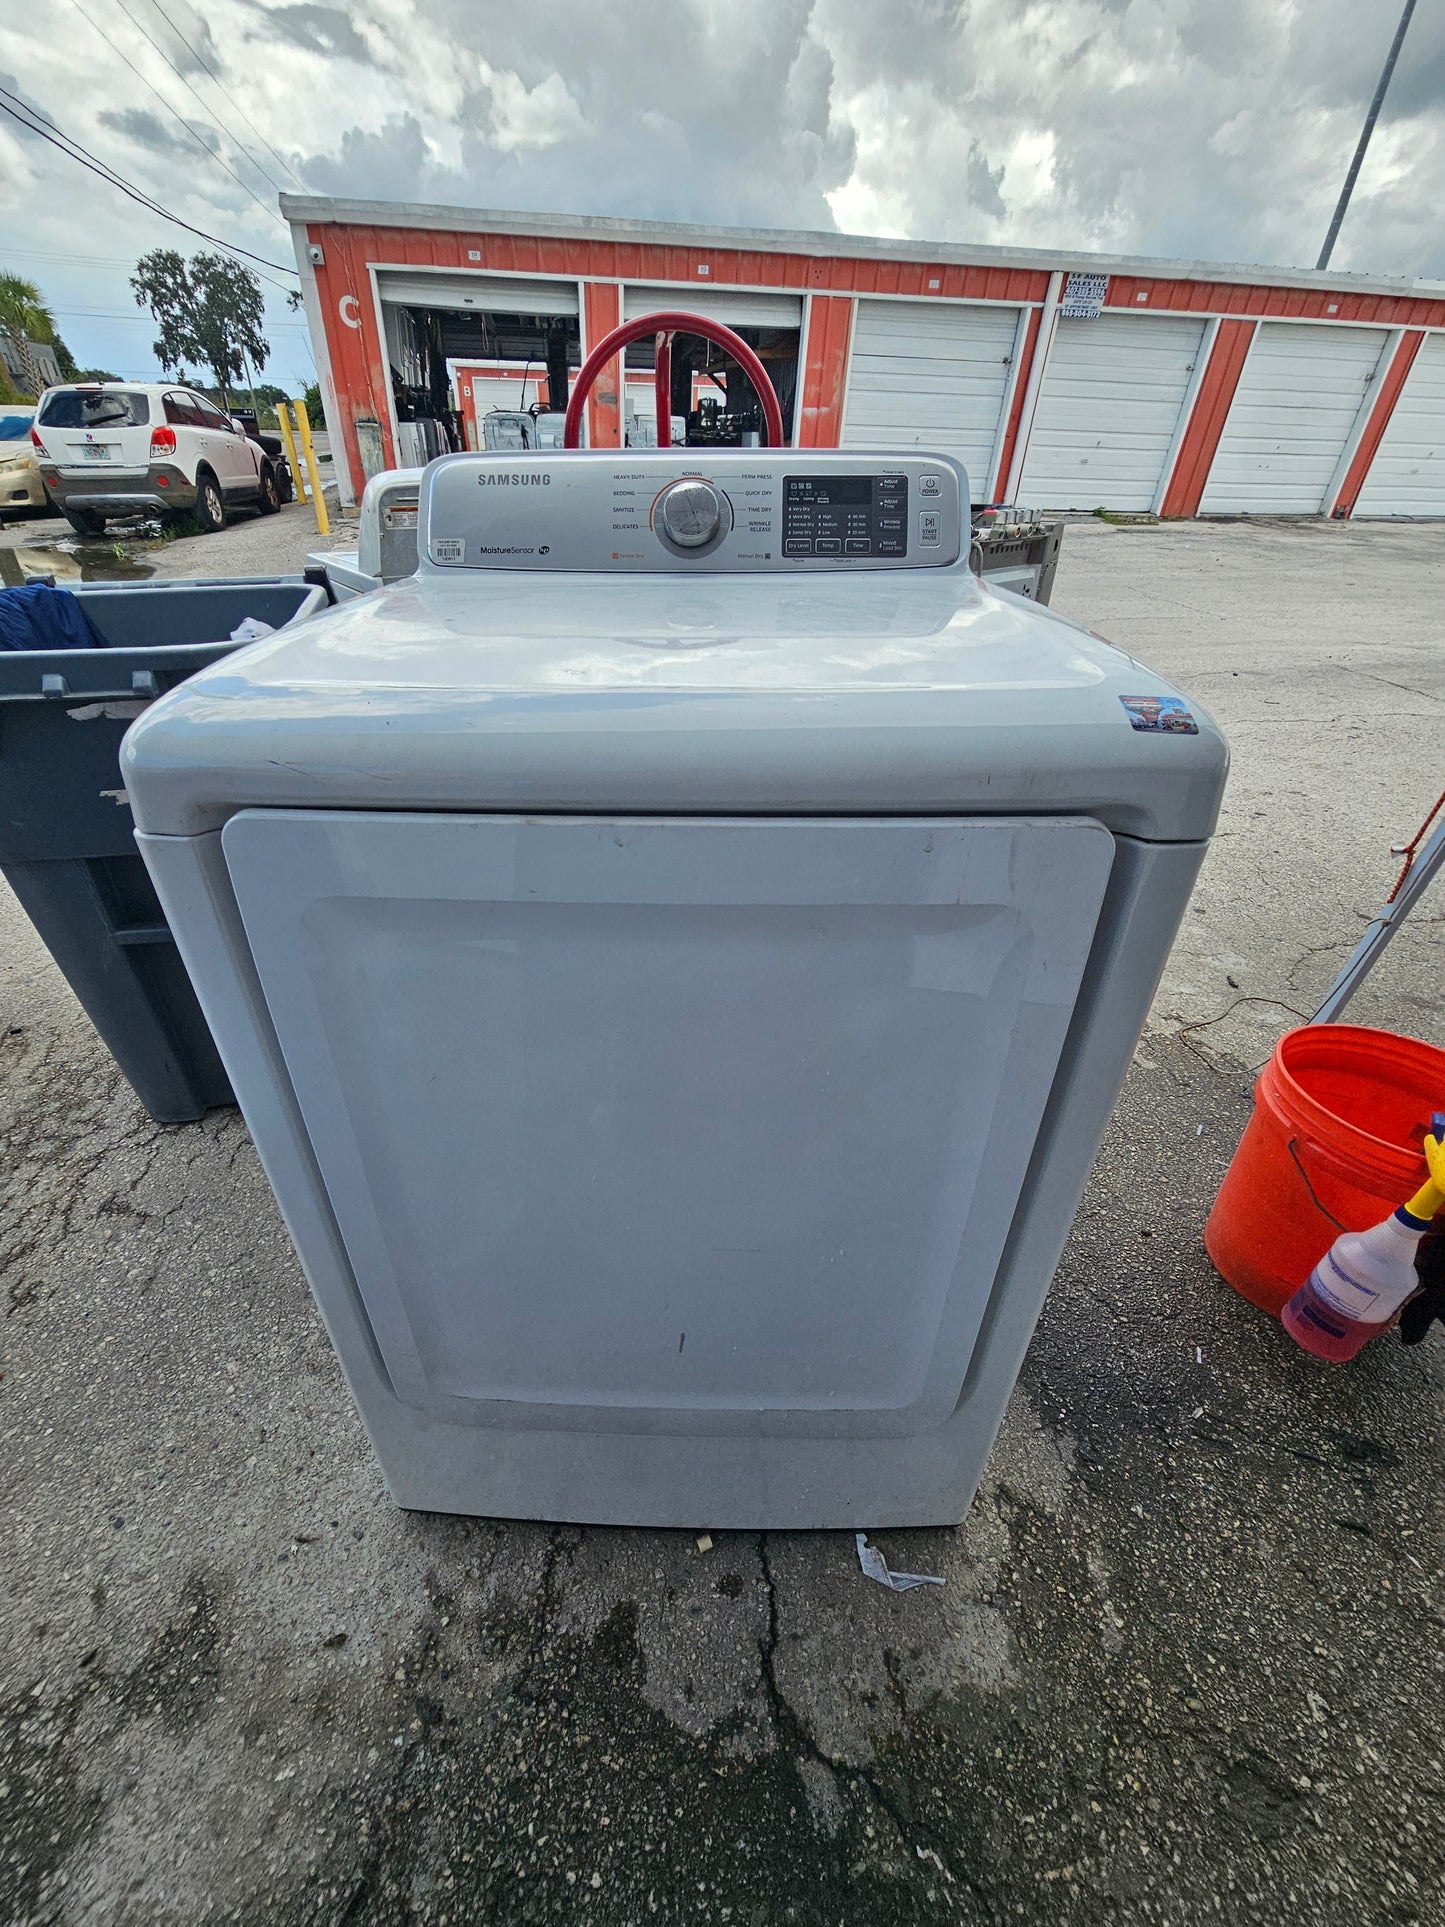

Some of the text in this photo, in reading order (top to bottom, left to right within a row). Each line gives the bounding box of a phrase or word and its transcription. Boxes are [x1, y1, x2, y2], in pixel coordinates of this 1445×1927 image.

[338, 294, 361, 329] C
[464, 386, 471, 396] B
[478, 474, 551, 486] SAMSUNG
[480, 546, 535, 554] MoistureSensor
